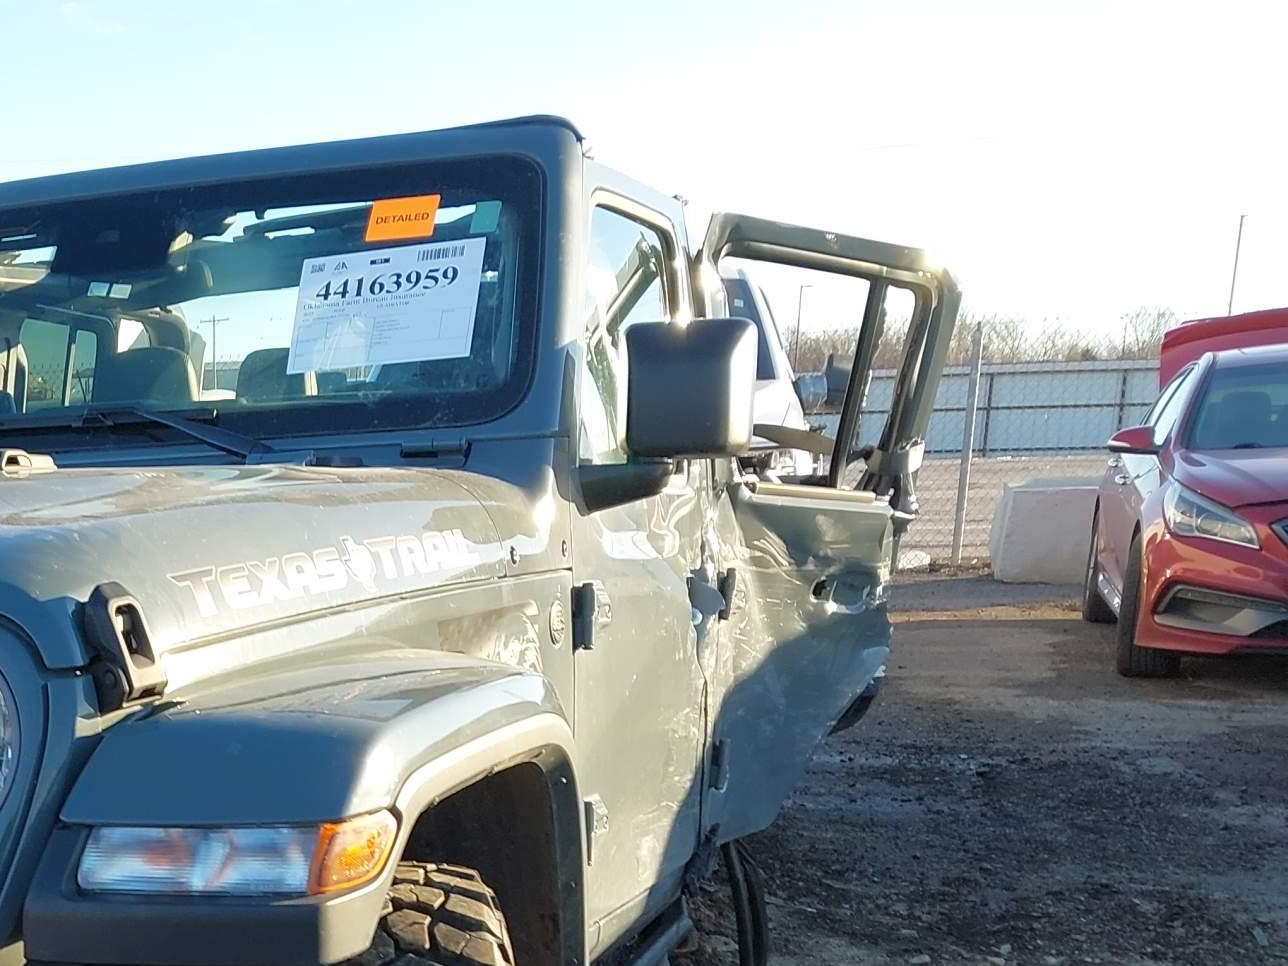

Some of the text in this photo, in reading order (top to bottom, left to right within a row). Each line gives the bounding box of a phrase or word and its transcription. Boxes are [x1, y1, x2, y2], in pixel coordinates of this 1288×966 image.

[375, 212, 430, 225] DETAILED
[315, 265, 459, 301] 44163959
[167, 529, 481, 617] TEXAS TRAIL
